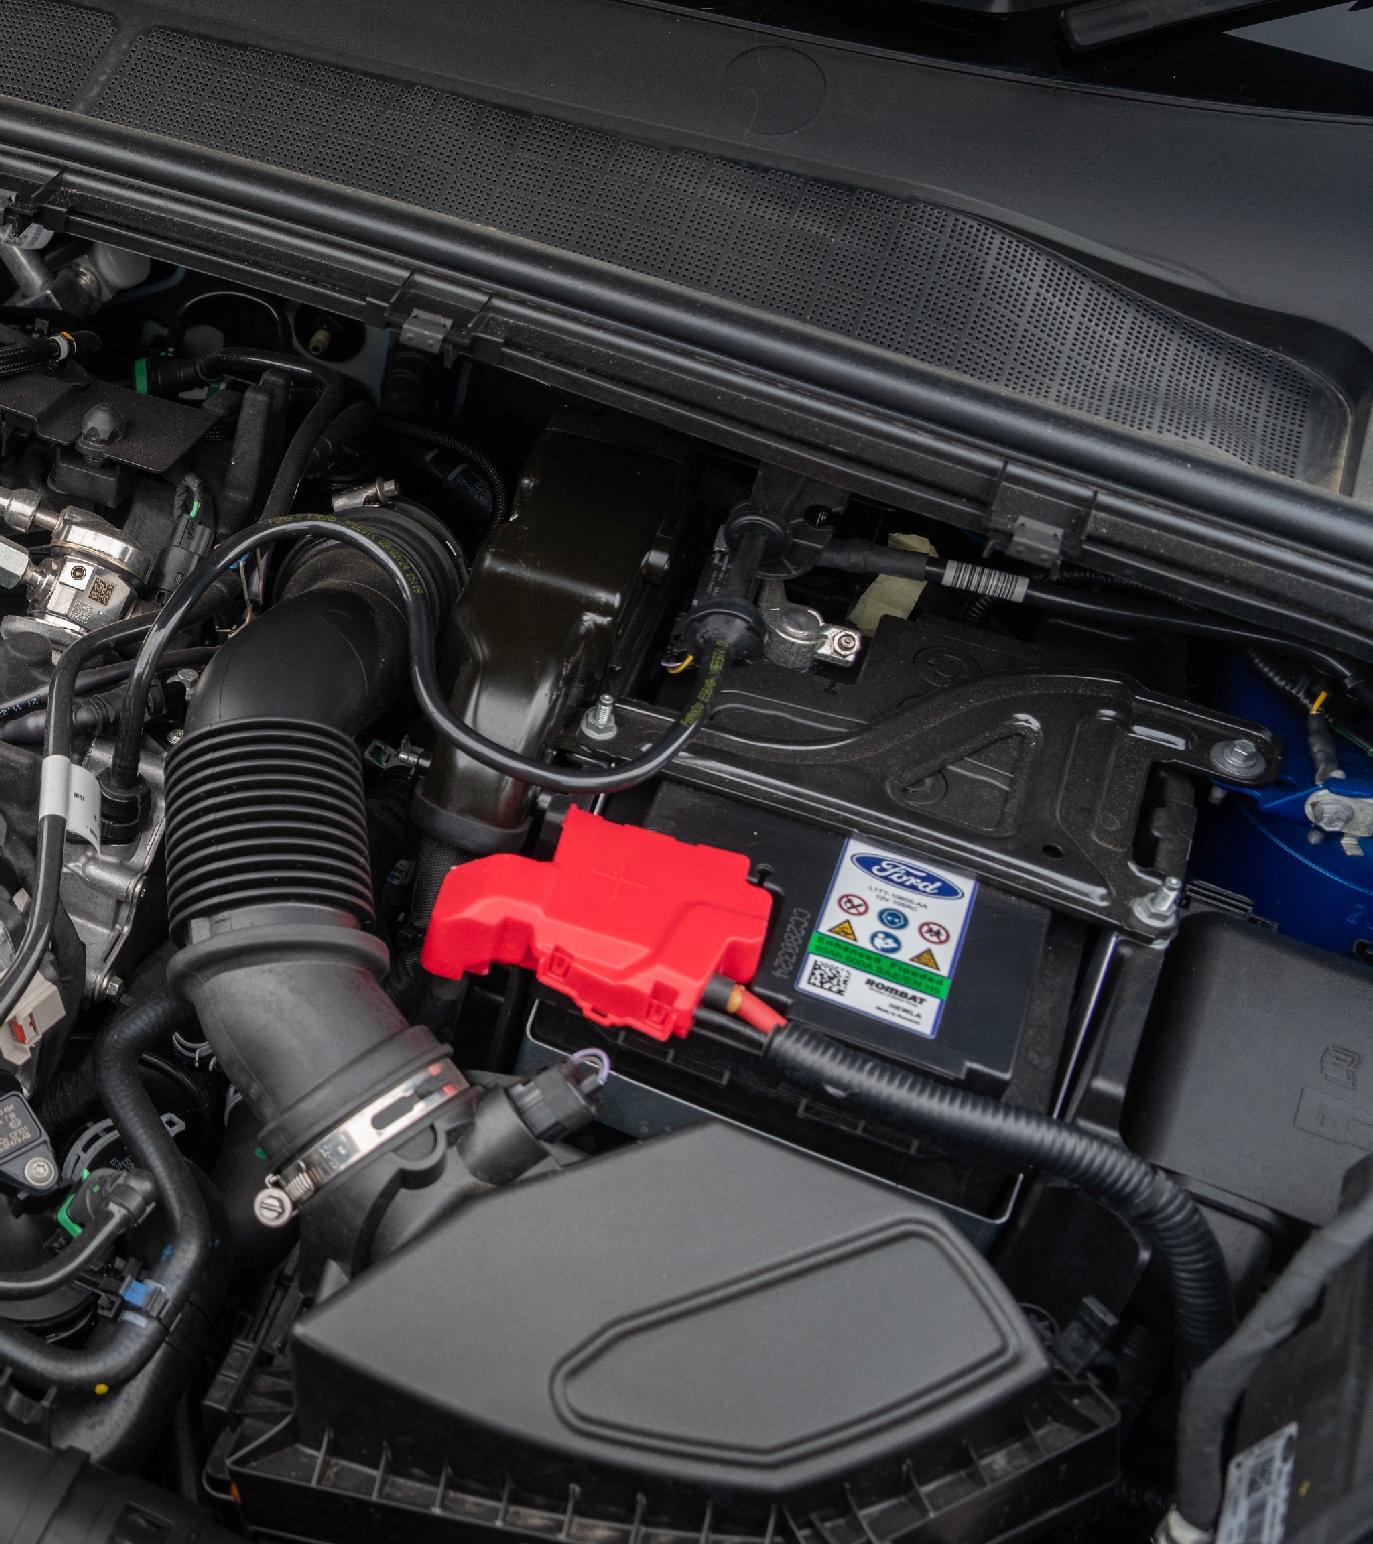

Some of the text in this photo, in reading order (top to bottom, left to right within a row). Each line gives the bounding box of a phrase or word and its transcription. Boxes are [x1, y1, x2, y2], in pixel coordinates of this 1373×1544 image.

[872, 860, 943, 895] Ford
[816, 935, 944, 986] Enhanced Flooded
